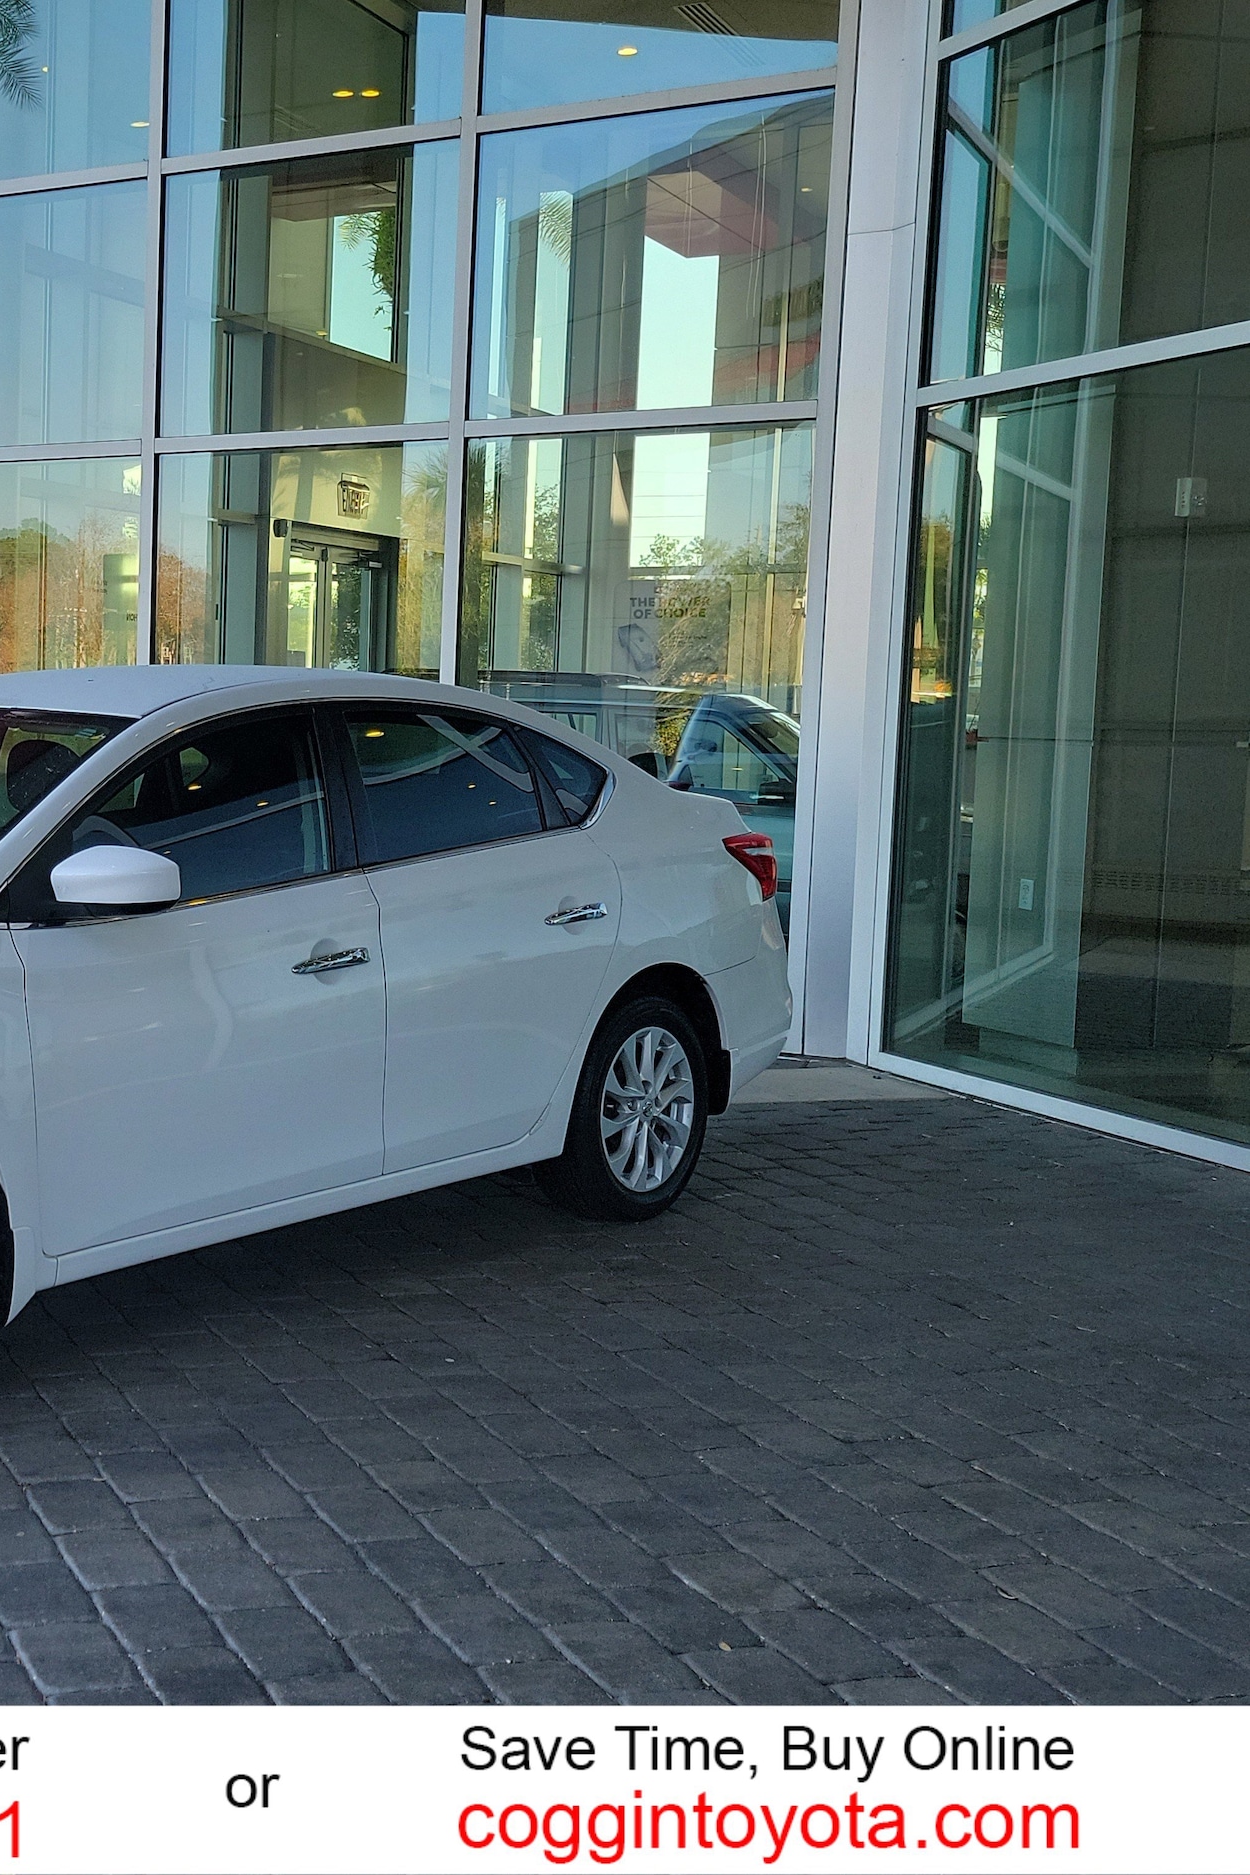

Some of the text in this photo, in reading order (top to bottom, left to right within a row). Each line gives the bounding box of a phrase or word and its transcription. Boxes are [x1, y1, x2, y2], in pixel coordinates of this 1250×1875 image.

[630, 597, 655, 607] THE
[633, 608, 706, 619] OF CHOICE
